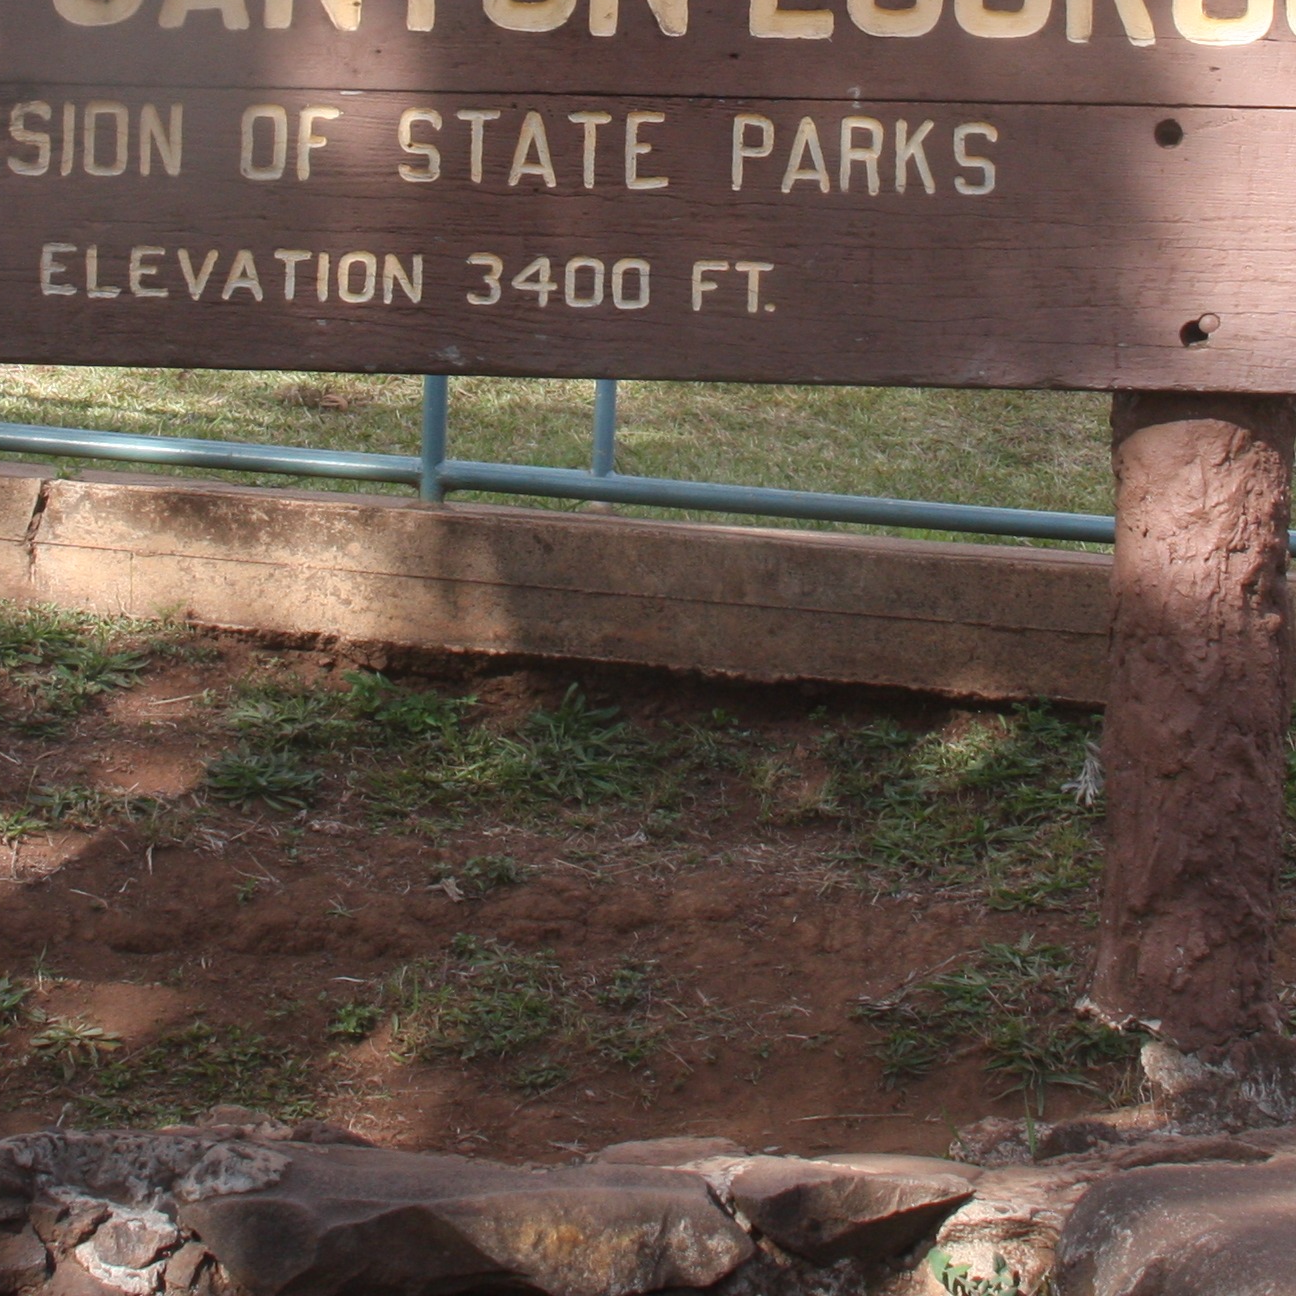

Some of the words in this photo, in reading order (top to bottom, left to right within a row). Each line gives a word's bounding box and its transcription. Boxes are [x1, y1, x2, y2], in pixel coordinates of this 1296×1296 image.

[240, 104, 344, 181] OF
[397, 108, 669, 190] STATE
[732, 116, 999, 197] PARKS
[40, 243, 424, 305] ELEVATION
[465, 253, 651, 310] 3400
[691, 261, 775, 314] FT.
